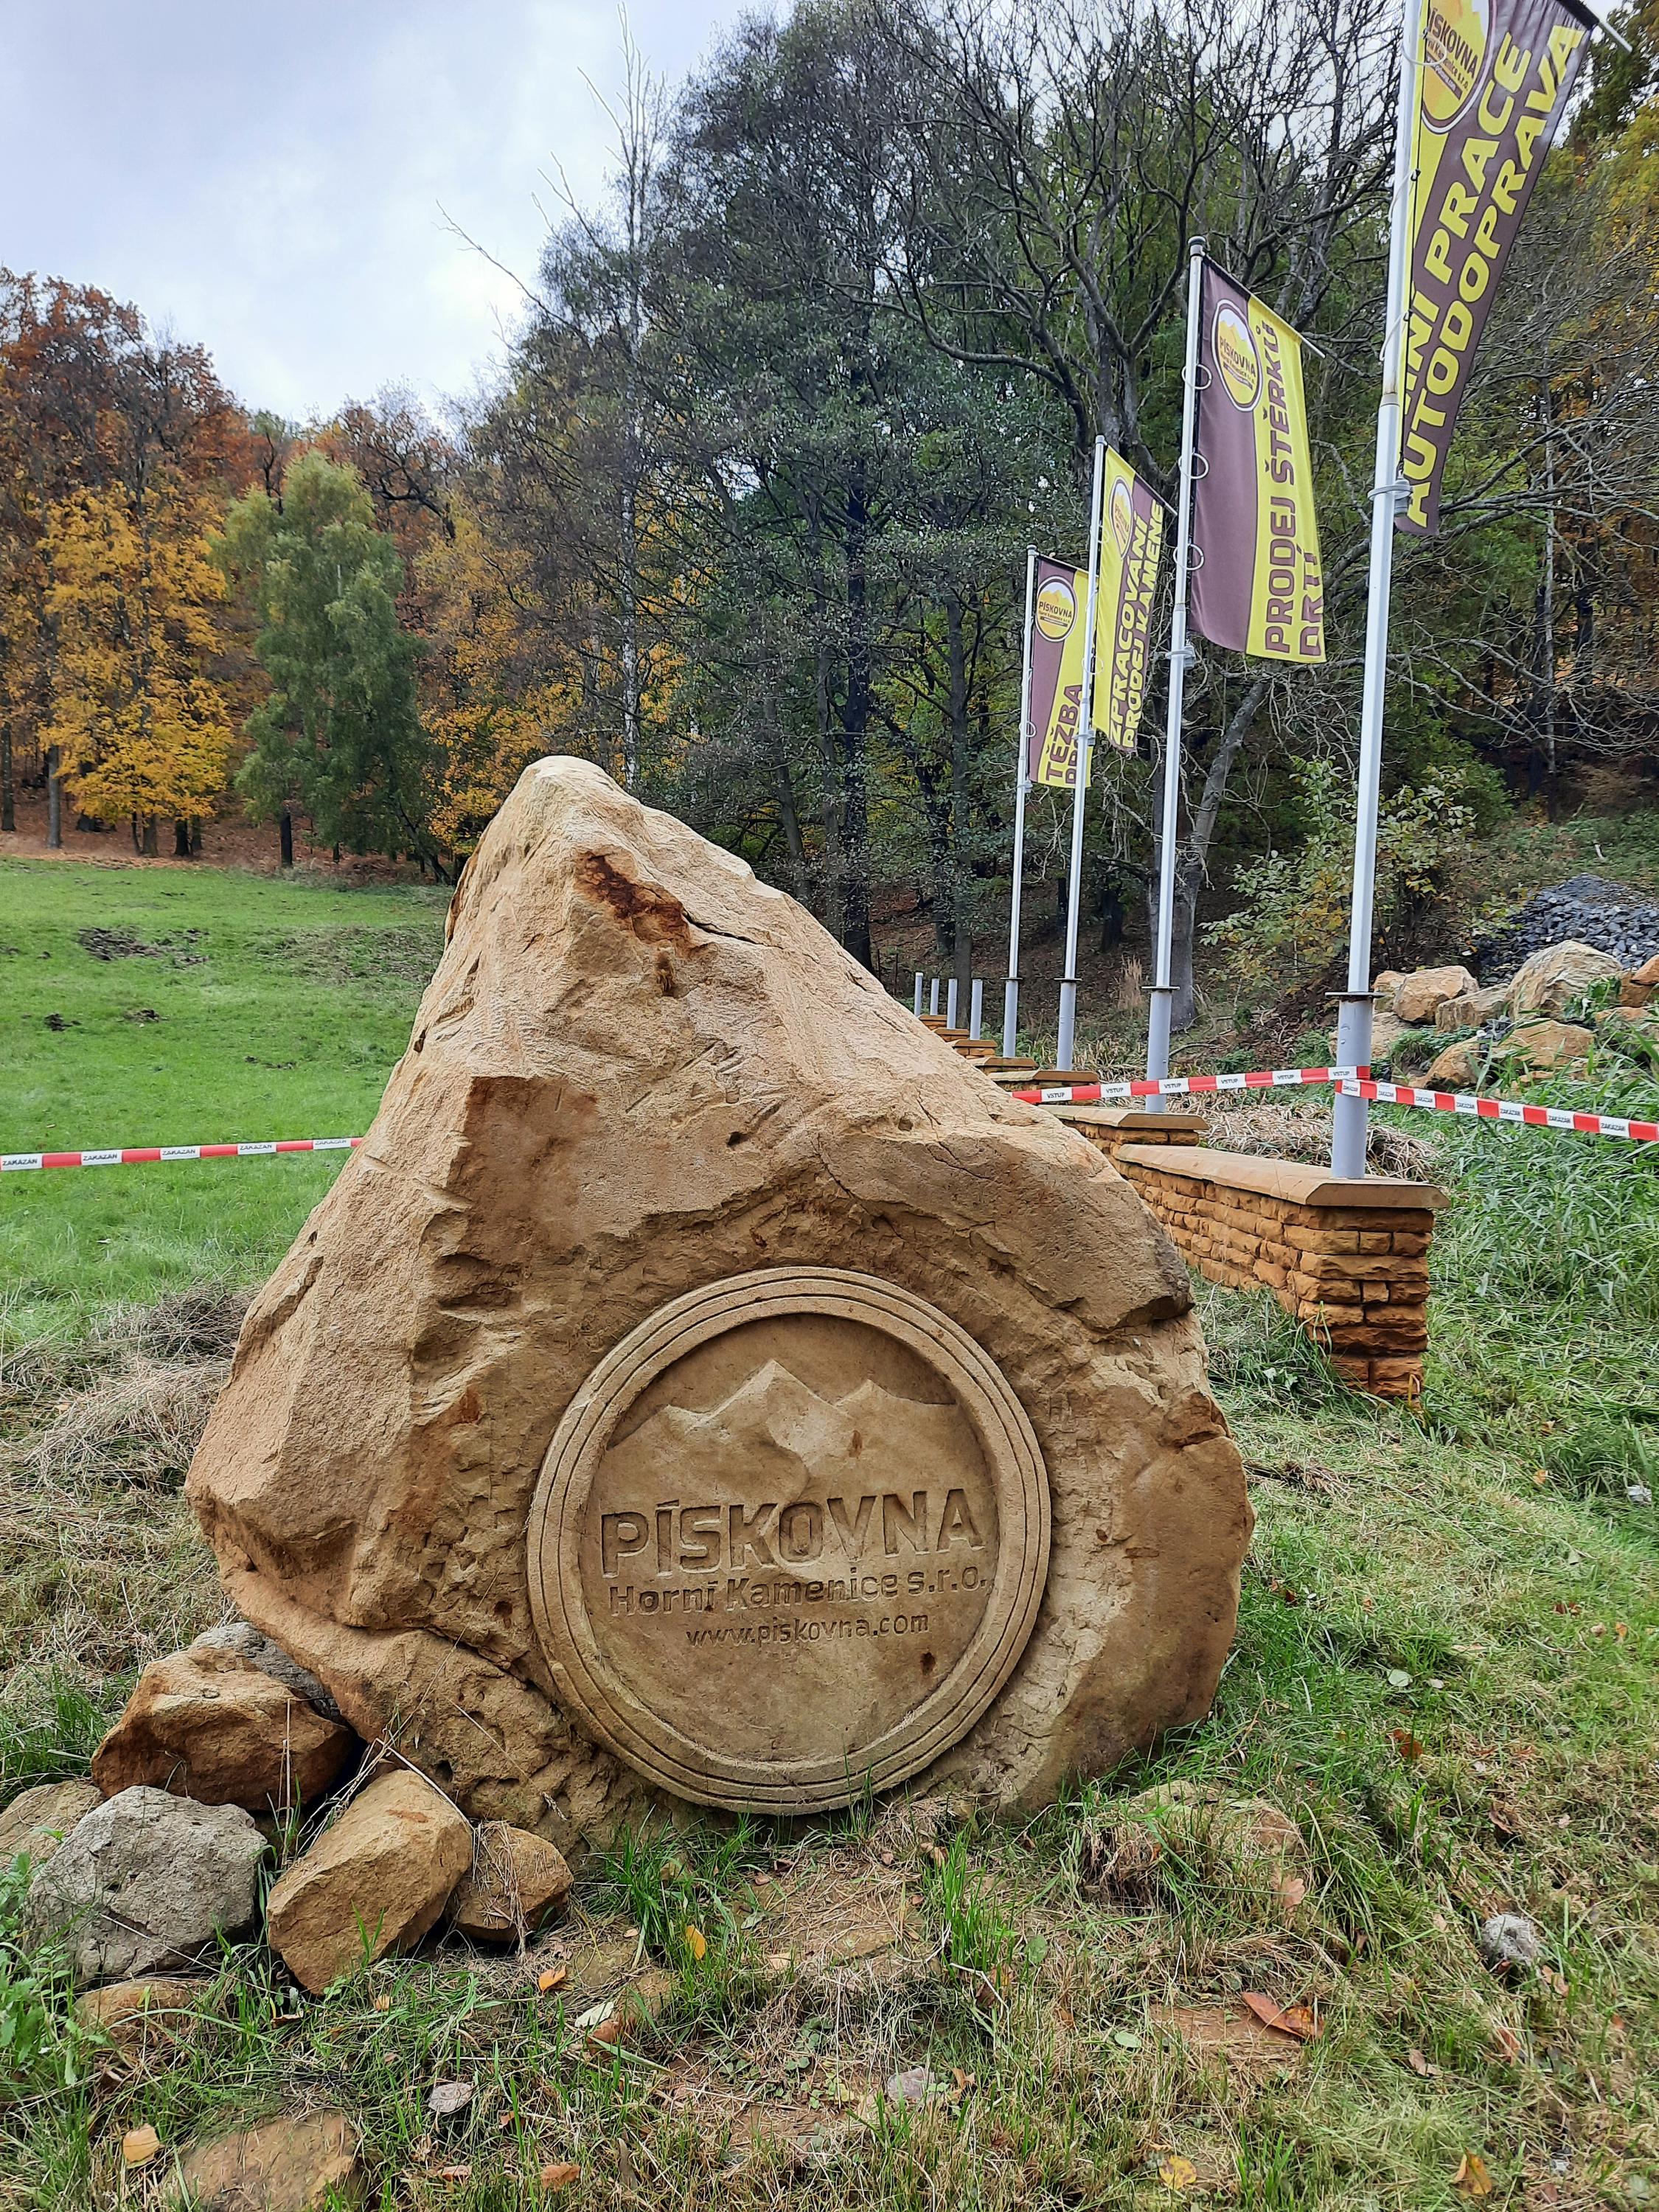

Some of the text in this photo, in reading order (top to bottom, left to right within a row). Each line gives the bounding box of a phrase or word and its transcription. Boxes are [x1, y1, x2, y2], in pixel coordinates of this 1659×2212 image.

[1427, 7, 1478, 79] ÍSKOVNA
[1424, 32, 1532, 285] PRACE
[1402, 24, 1585, 528] AUTODOPRAVA
[1256, 320, 1296, 653] PRODEJ ŠTĚRKŮ
[1038, 601, 1071, 619] PÍSKOVNA
[1110, 509, 1148, 745] ZPRACOVÁNÍ
[1122, 498, 1164, 748] PRODEJ KAMENE
[1045, 684, 1082, 782] TĚŽBA
[601, 1488, 986, 1578] PÍSKOVNA
[610, 1565, 988, 1617] Horní Kamenice s.r.o.
[686, 1613, 929, 1649] www.piskovna.com
